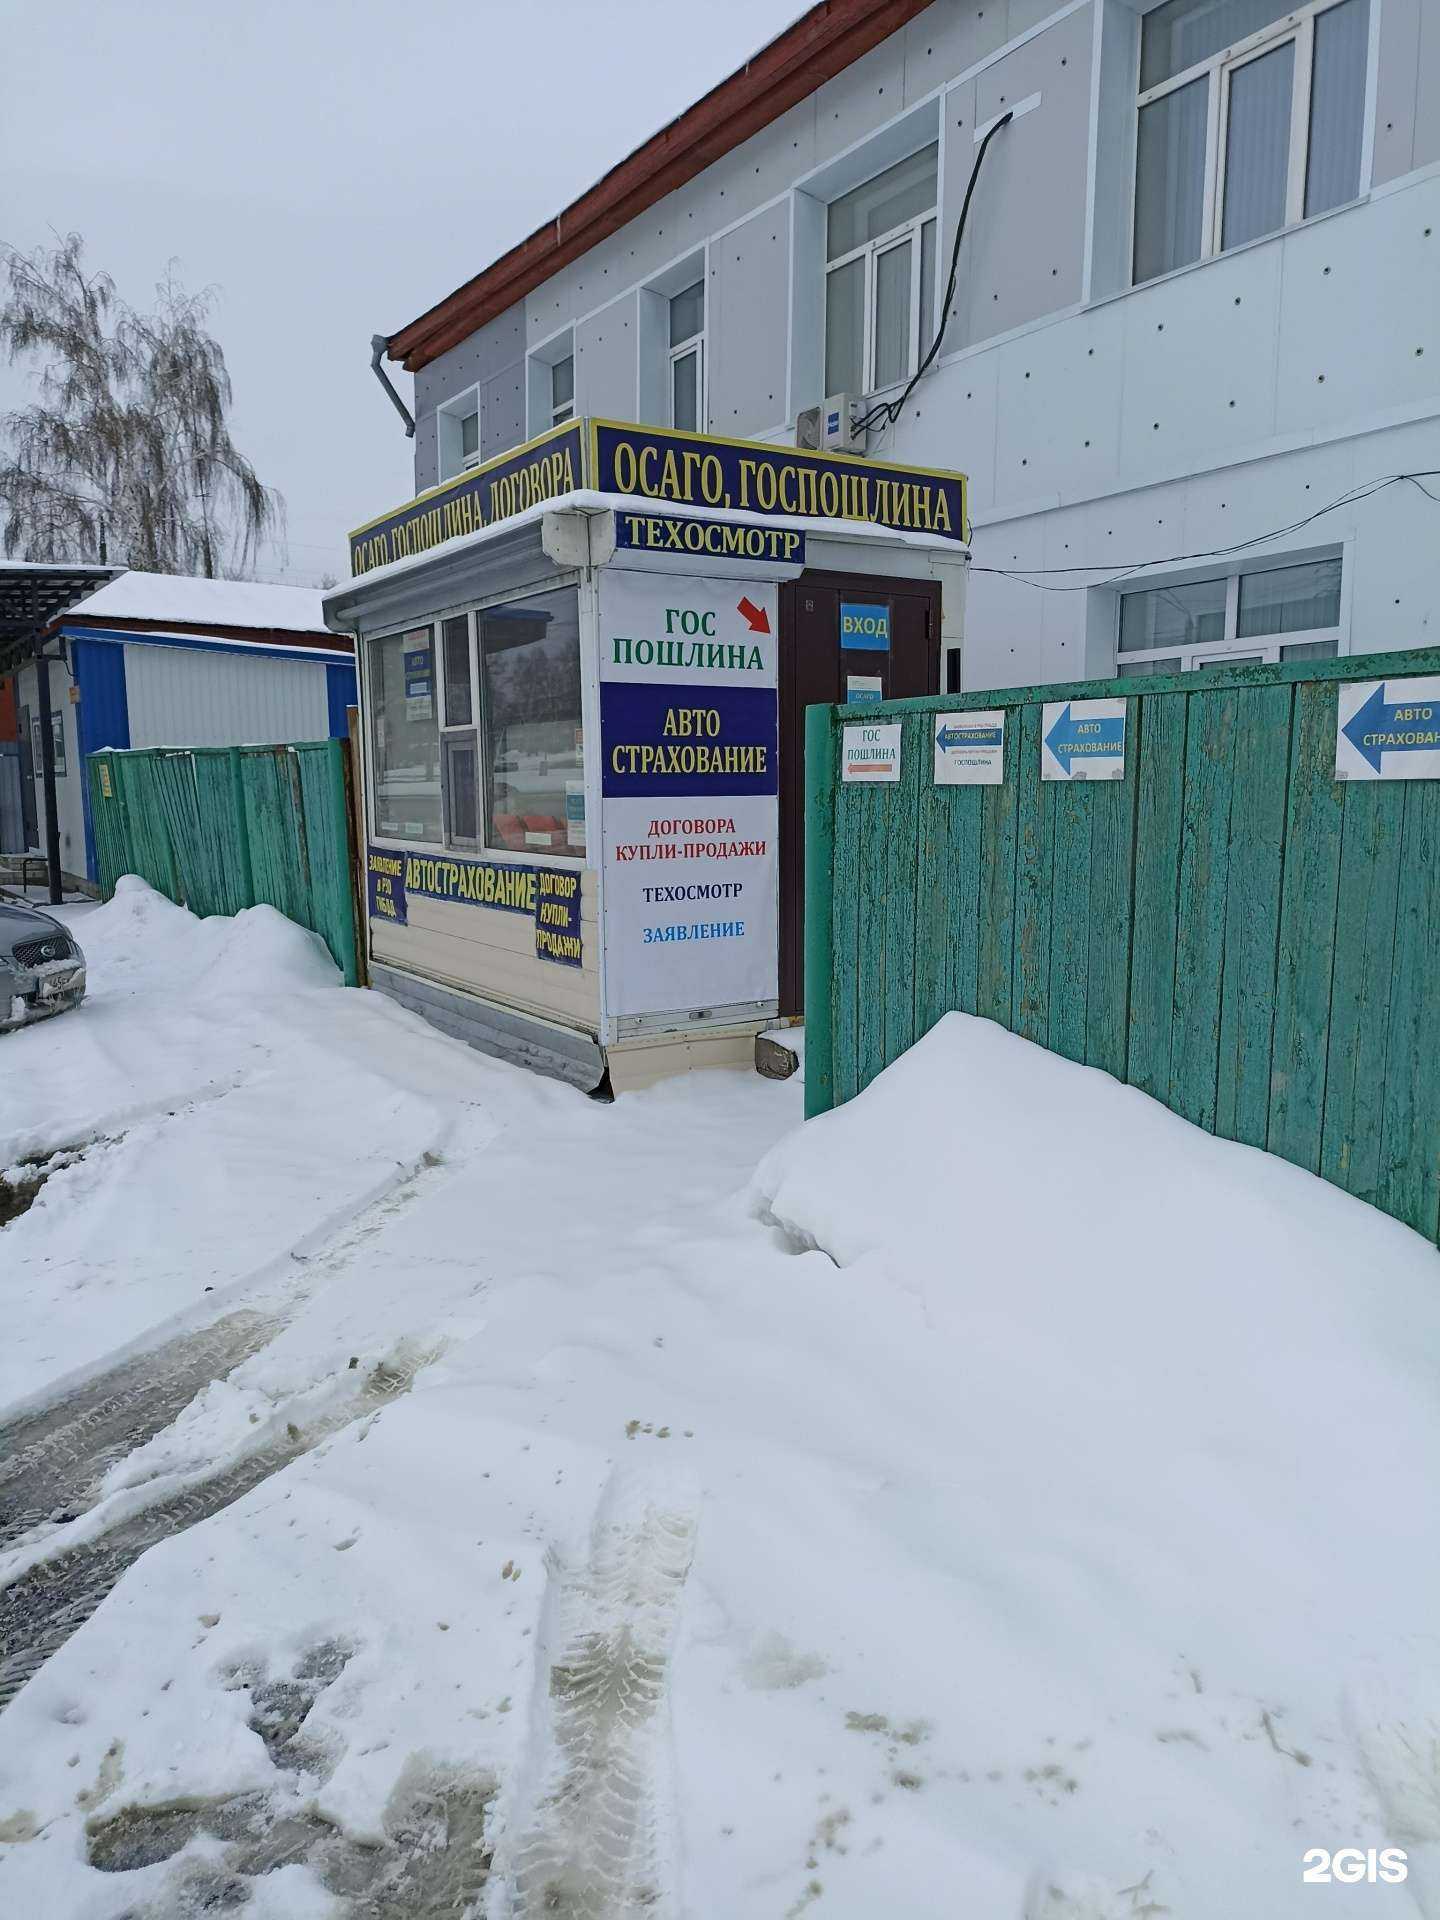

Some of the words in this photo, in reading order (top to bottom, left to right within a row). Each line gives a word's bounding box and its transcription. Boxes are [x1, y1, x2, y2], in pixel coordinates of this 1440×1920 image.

[490, 447, 575, 524] ДОГОВОРА
[613, 442, 731, 509] ОСАГО,
[738, 458, 952, 532] ГОСПОШЛИНА
[624, 516, 800, 560] ТЕХОСМОТР
[665, 608, 716, 636] ГОС
[843, 616, 888, 639] ВХОД
[612, 638, 764, 671] ПОШЛИНА
[663, 708, 721, 737] АВТО
[1394, 707, 1433, 721] АВТО
[862, 729, 881, 742] ГОС
[1077, 723, 1101, 734] АВТО
[612, 745, 767, 774] СТРАХОВАНИЕ
[847, 748, 896, 761] ПОШЛИНА
[1057, 741, 1122, 754] СТРАХОВАНИЕ
[647, 818, 736, 838] ДОГОВОРА
[616, 841, 766, 861] КУПЛИ-ПРОДАЖИ
[404, 857, 537, 911] АВТОСТРАХОВАНИЕ
[539, 873, 577, 898] ДОГОВОР
[642, 883, 743, 903] ТЕХОСМОТР
[540, 902, 572, 928] КУПЛИ-
[536, 929, 581, 958] ПРОДАЖИ
[643, 922, 745, 944] ЗАЯВЛЕНИЕ
